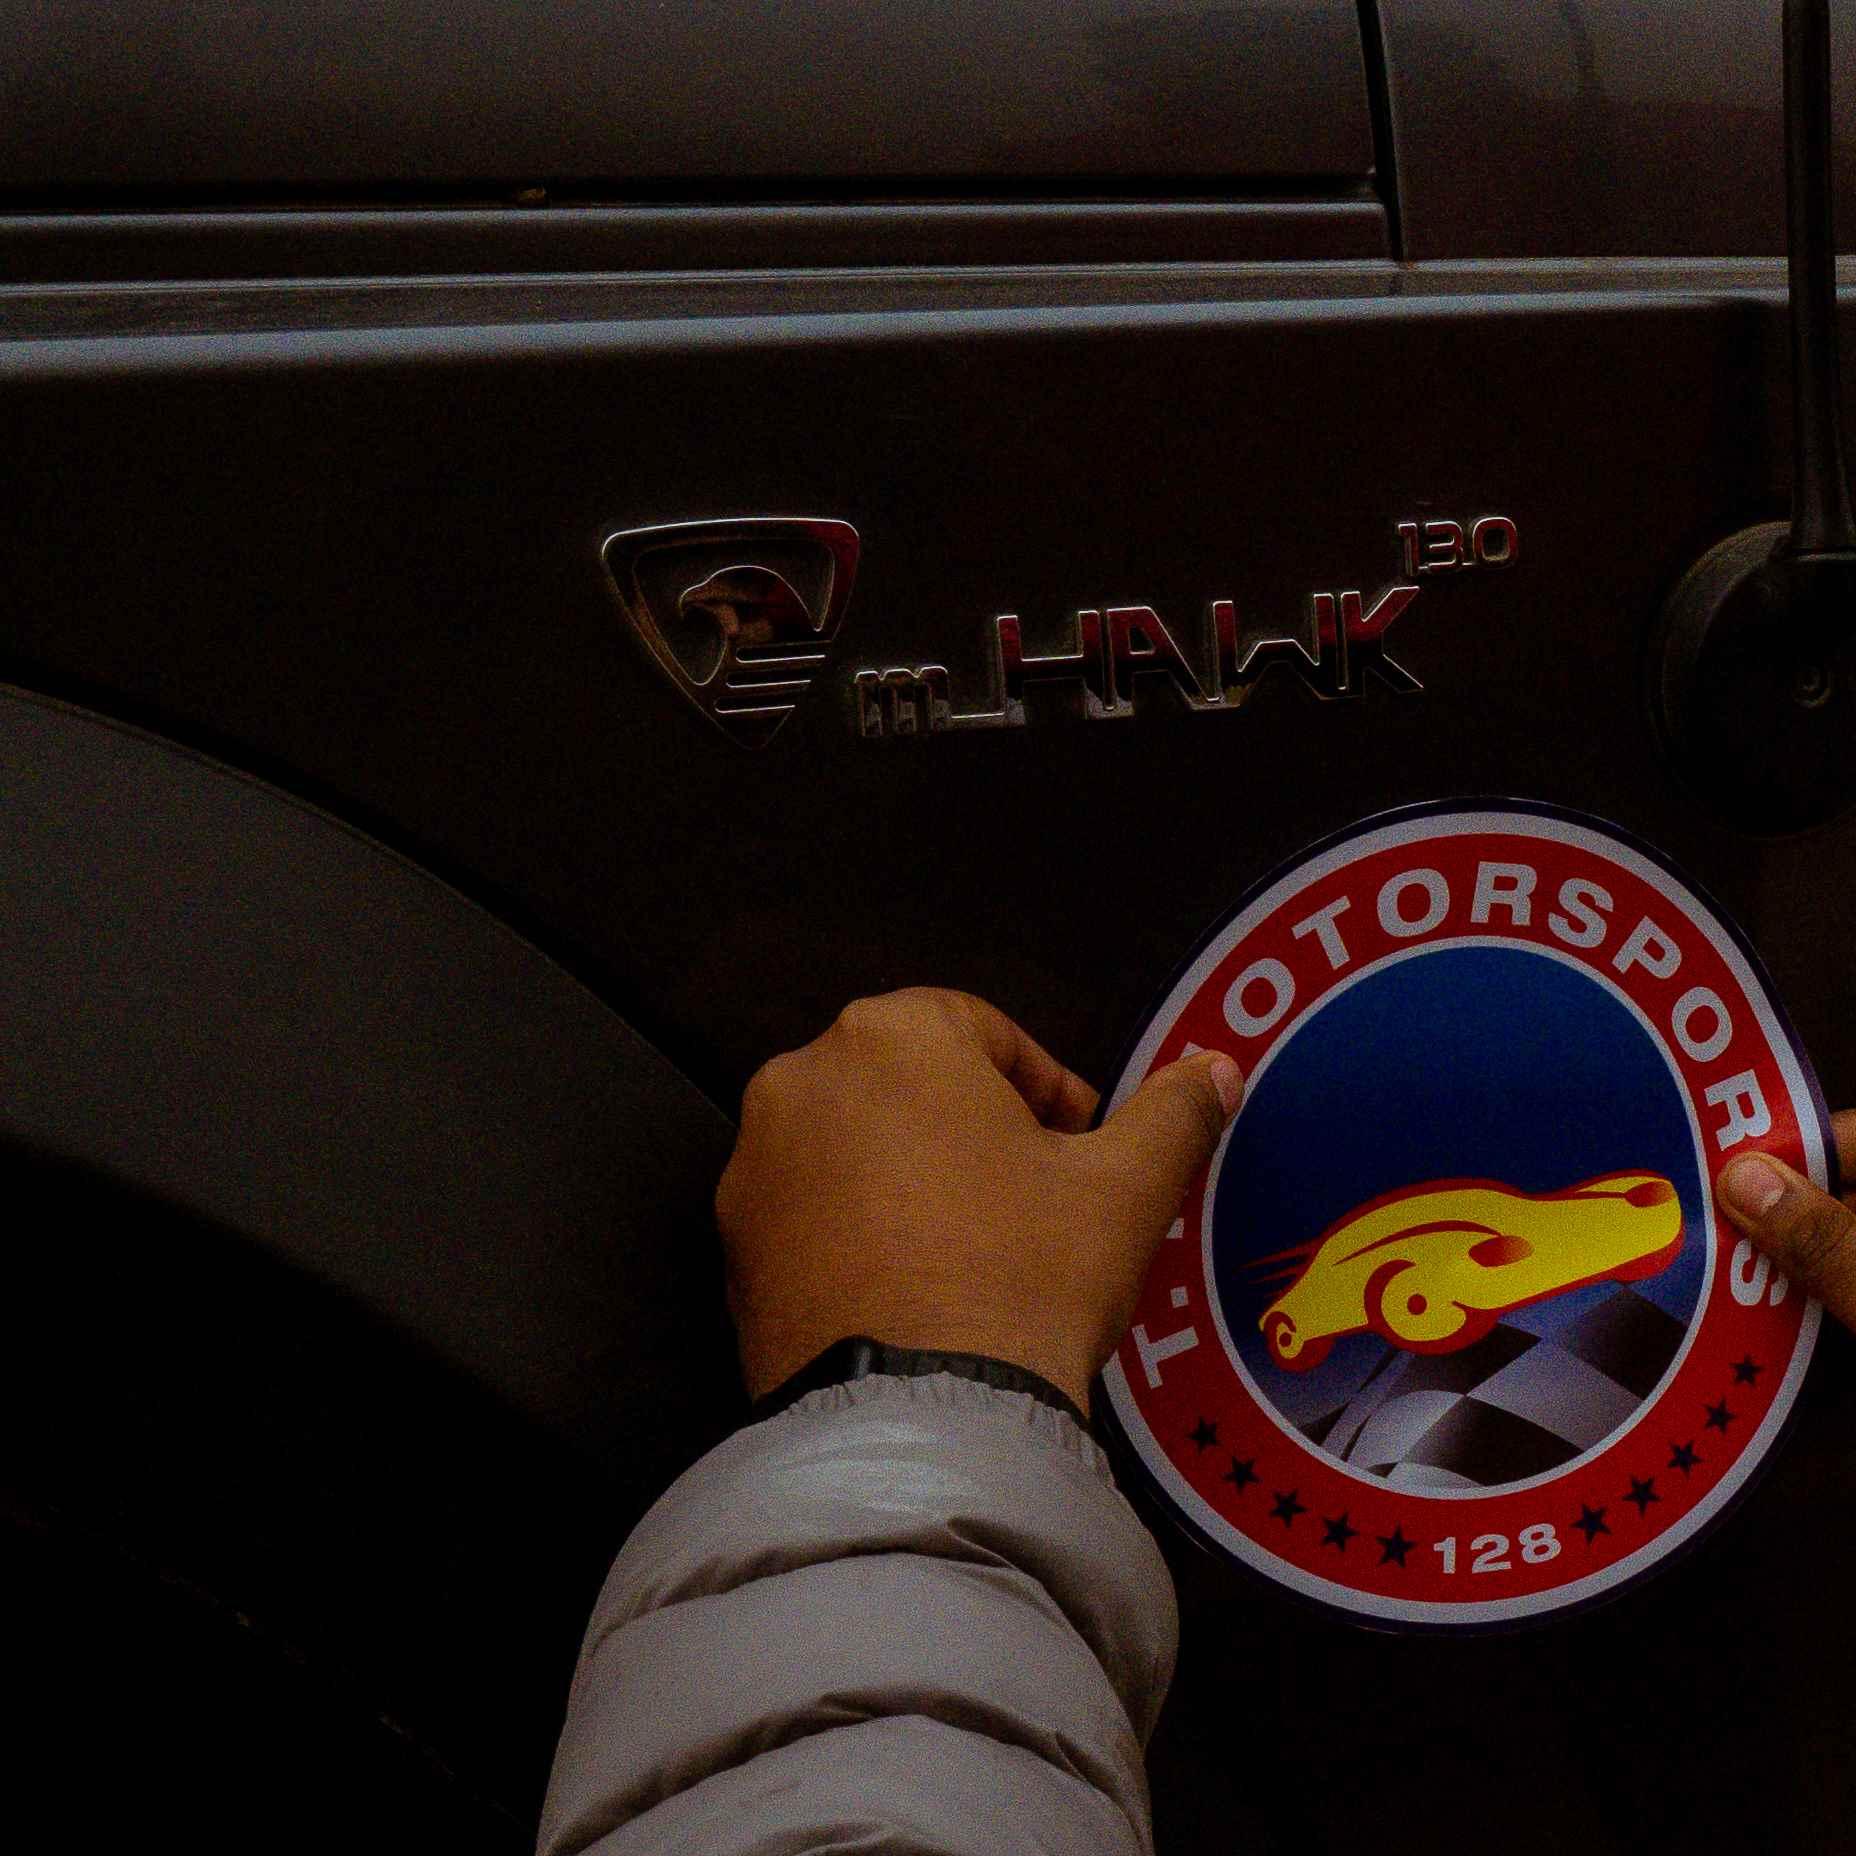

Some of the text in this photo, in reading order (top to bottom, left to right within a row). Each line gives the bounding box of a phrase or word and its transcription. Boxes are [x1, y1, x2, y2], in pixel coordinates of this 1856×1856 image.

[1397, 516, 1520, 577] 130
[1178, 860, 1790, 1308] OTORSPORS
[1433, 1522, 1562, 1575] 128
